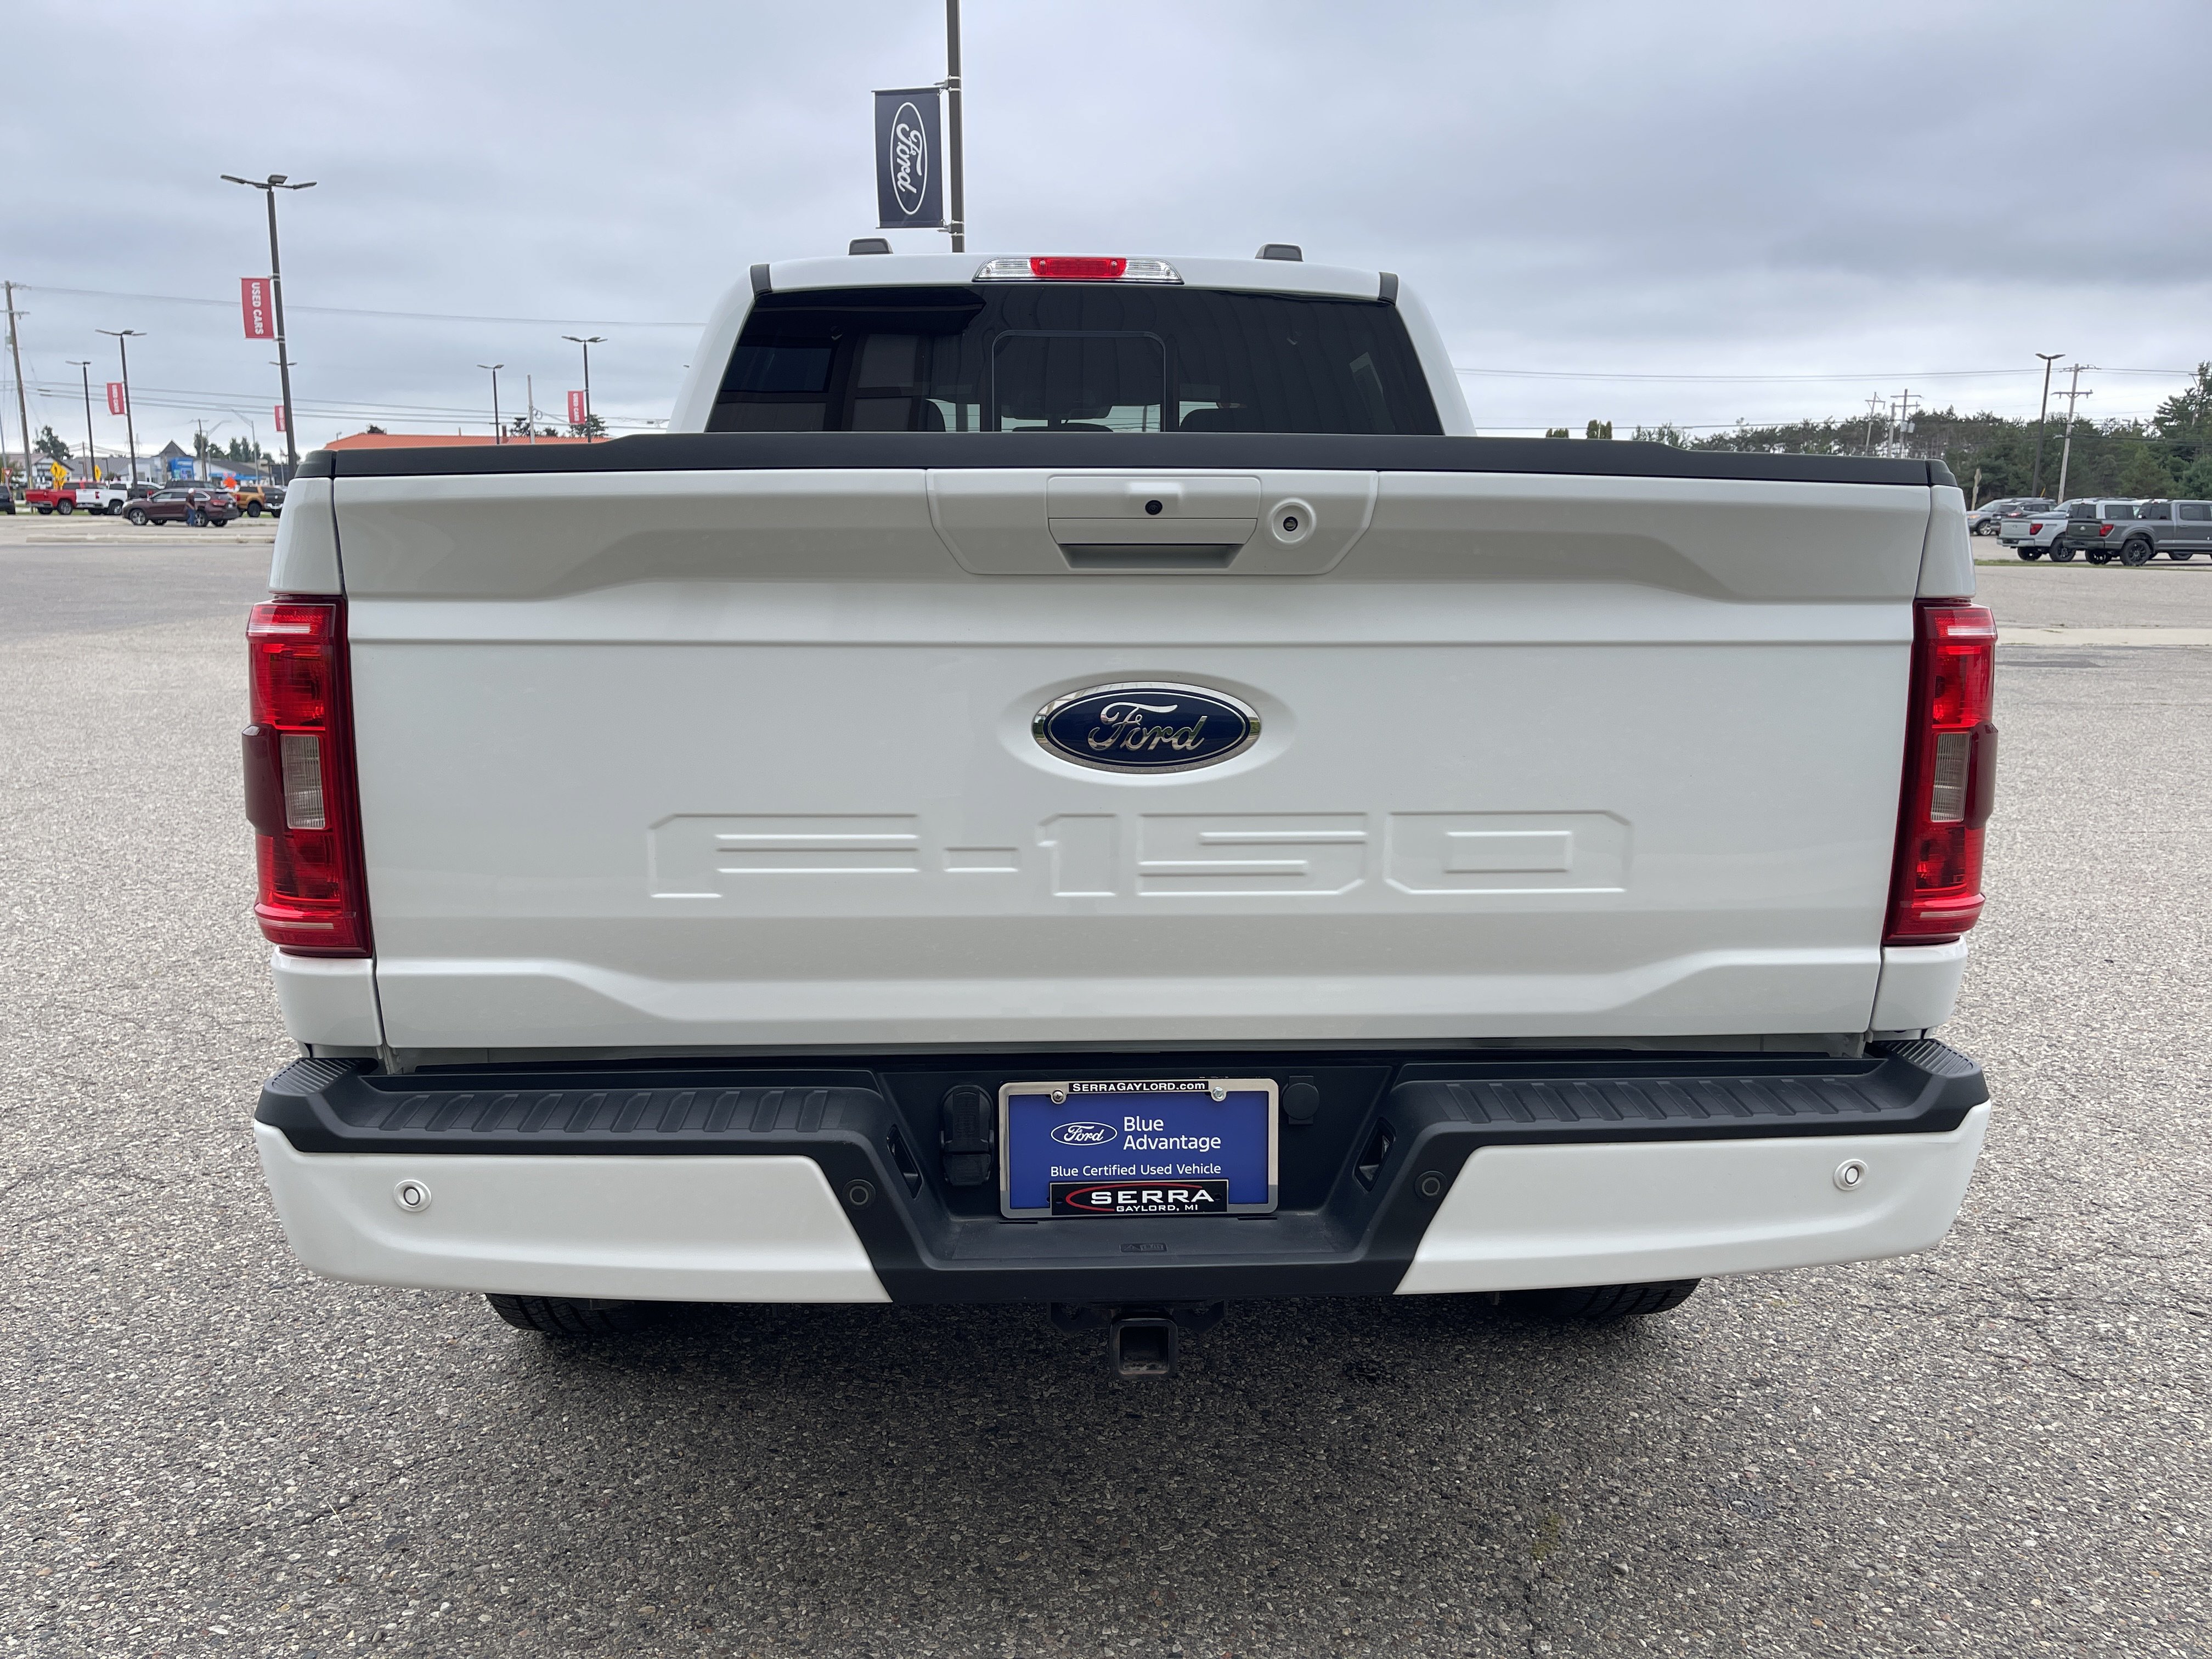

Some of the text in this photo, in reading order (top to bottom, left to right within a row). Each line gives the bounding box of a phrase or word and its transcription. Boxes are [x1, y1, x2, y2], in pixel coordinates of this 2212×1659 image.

[896, 123, 922, 193] Ford
[251, 282, 264, 335] USED CARS
[1088, 702, 1207, 751] Ford
[646, 810, 1632, 899] F-150
[1073, 1082, 1205, 1092] SERRAGAYLORD.com
[1124, 1116, 1164, 1132] Blue
[1063, 1125, 1104, 1142] Ford
[1123, 1135, 1221, 1152] Advantage
[1051, 1163, 1221, 1177] Blue Certified Used Vehicle
[1091, 1189, 1214, 1204] SERRA
